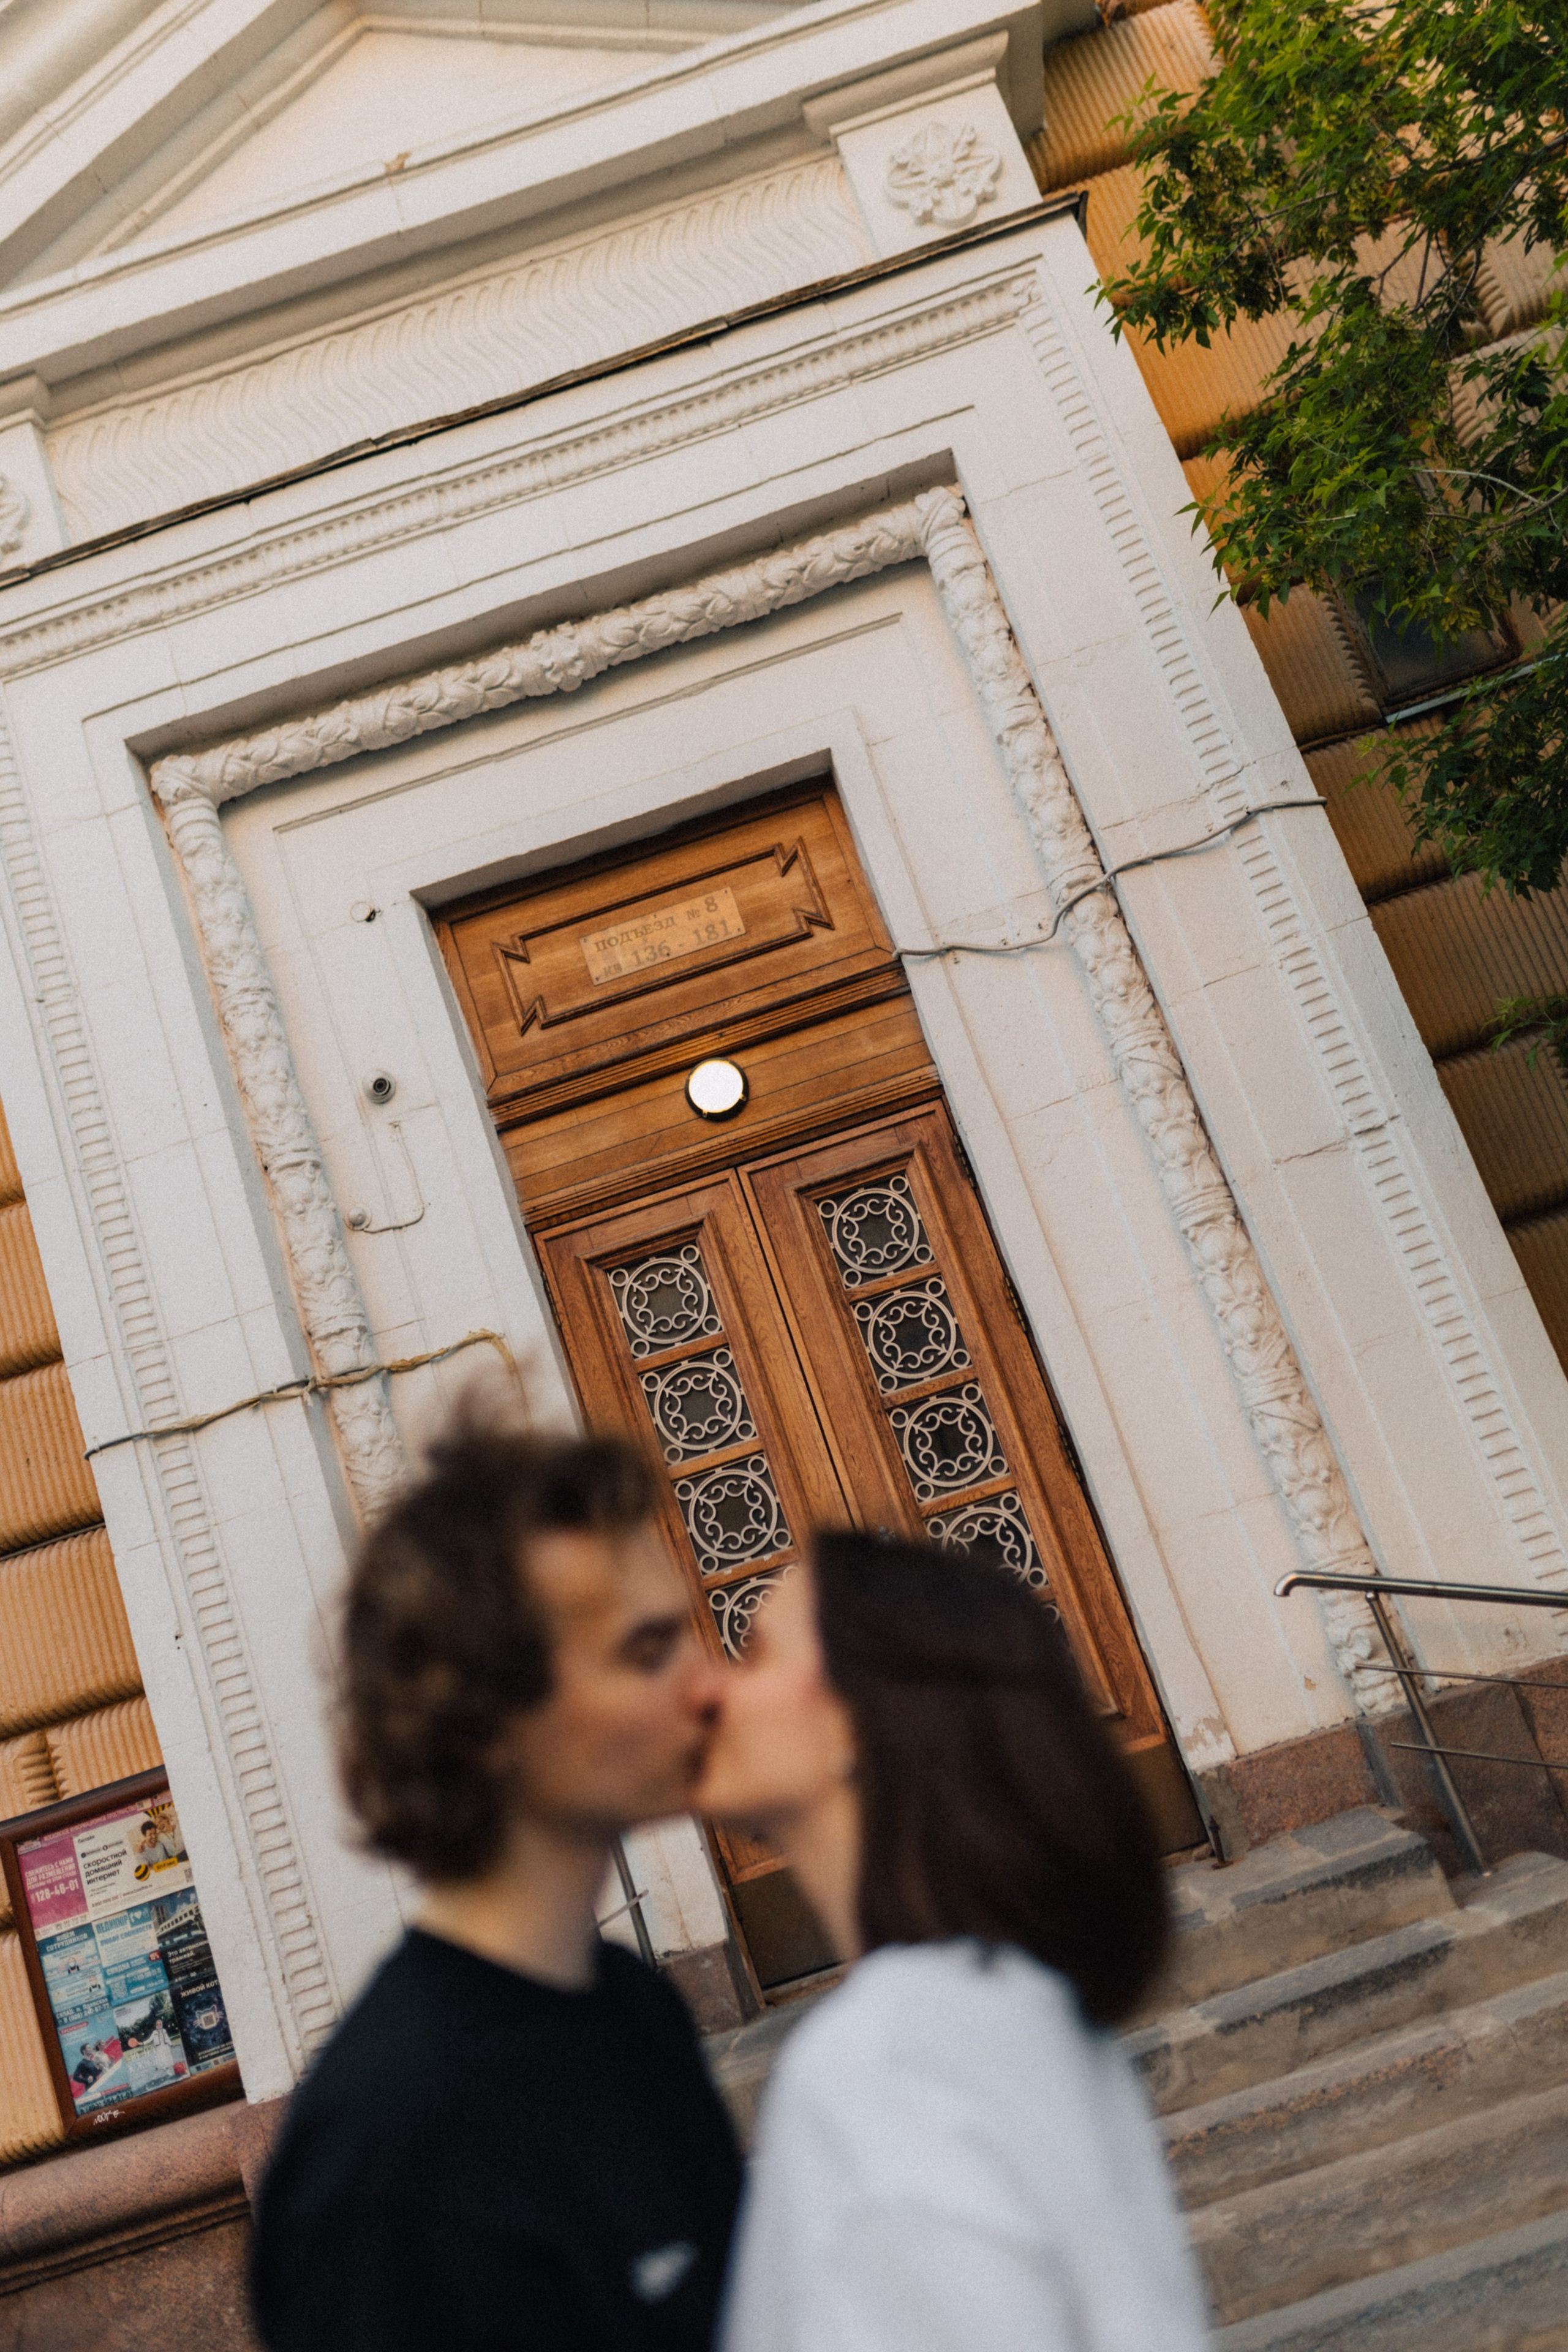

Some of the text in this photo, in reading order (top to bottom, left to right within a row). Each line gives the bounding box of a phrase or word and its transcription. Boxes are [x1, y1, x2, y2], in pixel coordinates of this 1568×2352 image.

[593, 915, 678, 951] ПОДЪЕЗД
[703, 895, 719, 913] 8
[630, 940, 673, 967] 136
[692, 918, 732, 945] 181
[83, 1849, 127, 1869] скоростной
[85, 1860, 122, 1877] домашний
[86, 1869, 120, 1885] интернет
[36, 1879, 79, 1902] 128-46-01
[47, 1934, 88, 1951] СОТРУДНИКОВ
[178, 1939, 208, 1953] автономн
[180, 1984, 205, 1997] ЖИВОЙ
